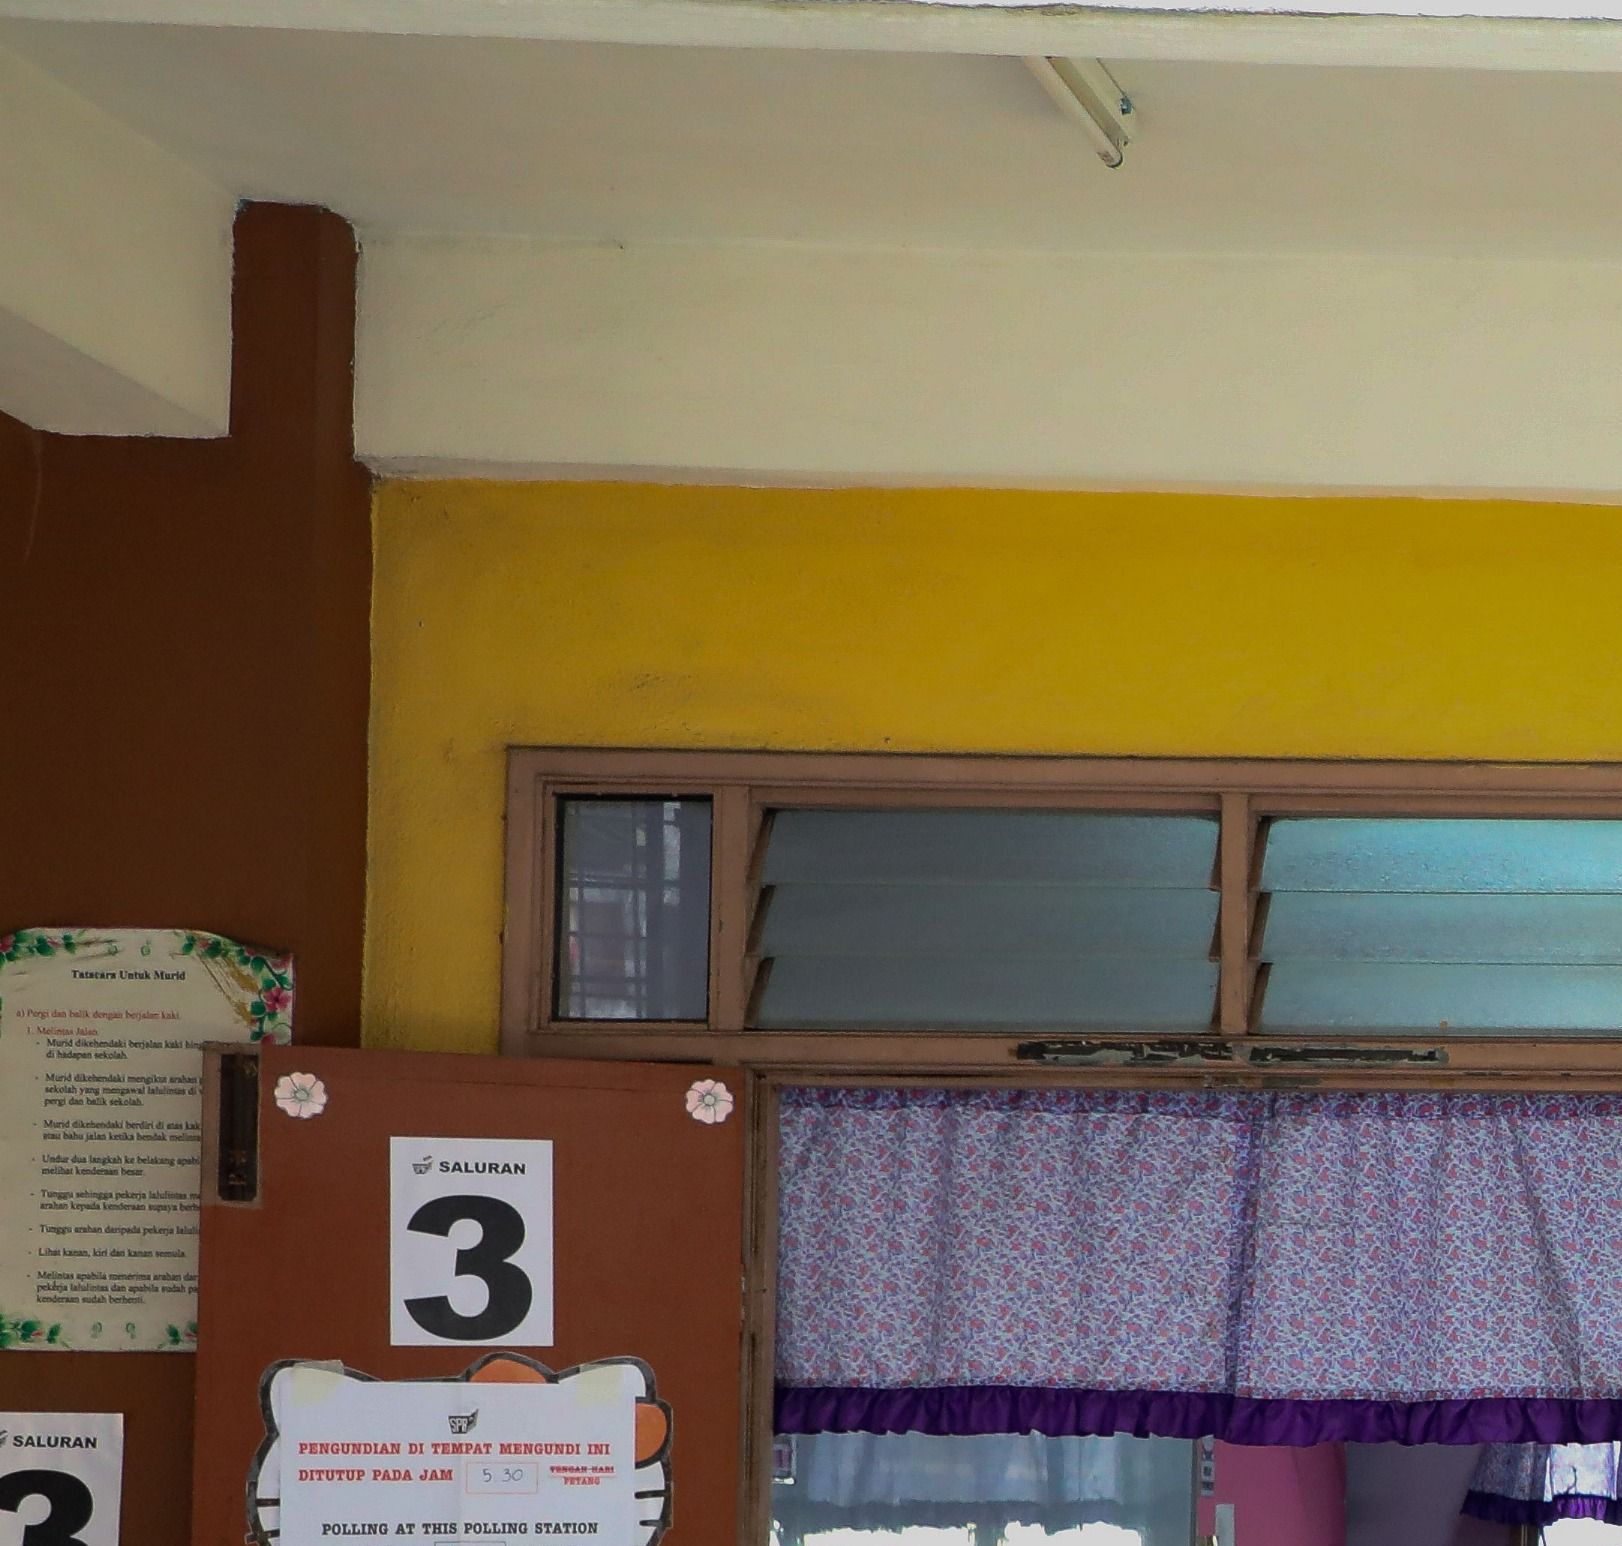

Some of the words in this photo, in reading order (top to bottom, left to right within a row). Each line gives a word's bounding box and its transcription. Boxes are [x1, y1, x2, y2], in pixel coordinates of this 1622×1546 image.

[71, 970, 116, 979] Tatacara
[118, 971, 150, 980] Untuk
[153, 971, 185, 980] Murid
[439, 1161, 526, 1175] SALURAN
[404, 1194, 533, 1341] 3
[12, 1434, 98, 1449] SALURAN
[298, 1442, 401, 1455] PENGUNDIAN
[408, 1442, 424, 1455] DI
[431, 1443, 492, 1455] TEMPAT
[500, 1443, 581, 1455] MENGUNDI
[587, 1444, 610, 1455] INI
[298, 1469, 366, 1482] DITUTUP
[372, 1469, 412, 1481] PADA
[419, 1469, 453, 1481] JAM
[482, 1468, 492, 1483] 5
[502, 1468, 523, 1482] 30
[563, 1477, 600, 1485] PETANG
[322, 1523, 388, 1535] POLLING
[396, 1523, 415, 1535] AT
[422, 1523, 457, 1534] THIS
[463, 1523, 528, 1534] POLLING
[534, 1523, 598, 1534] STATION
